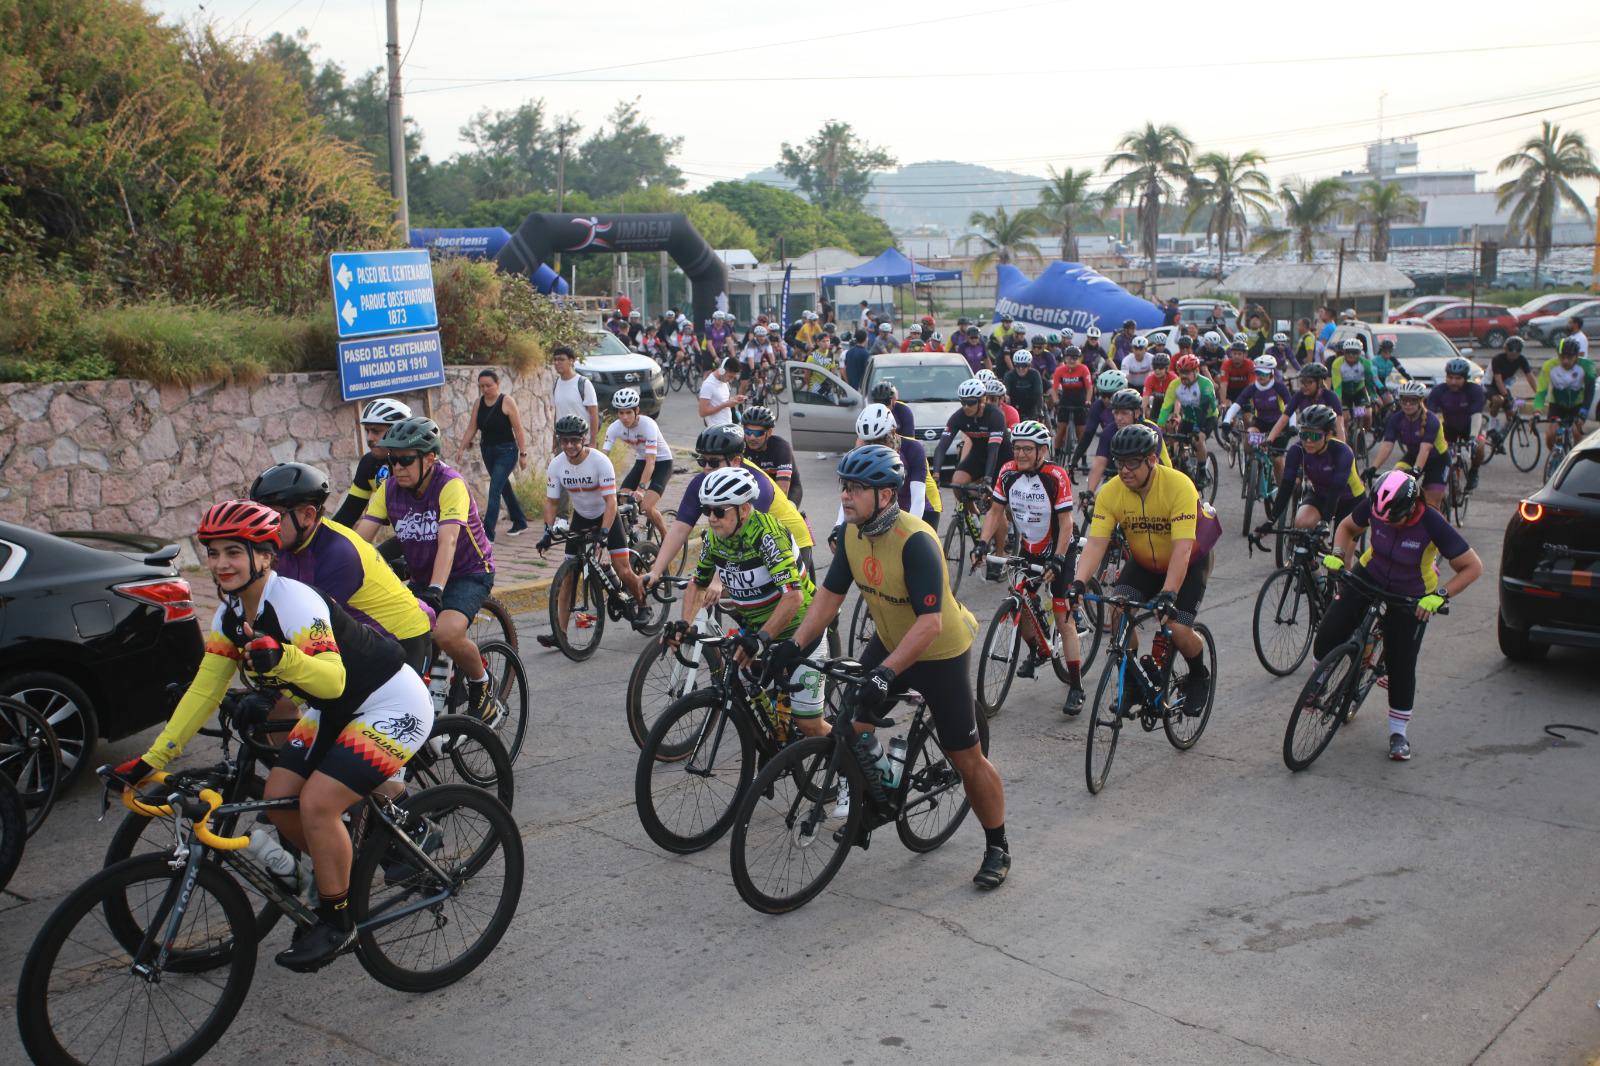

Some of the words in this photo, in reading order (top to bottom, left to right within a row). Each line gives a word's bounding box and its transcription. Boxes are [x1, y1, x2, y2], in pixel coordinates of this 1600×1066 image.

[616, 220, 672, 239] IMDEM
[357, 266, 379, 284] PASEO
[378, 266, 391, 284] DEL
[392, 263, 430, 283] CENTENARIO
[360, 292, 387, 311] PARQUE
[387, 288, 433, 308] OBSERVATORIO
[388, 309, 407, 325] 1873
[344, 348, 371, 363] PASEO
[373, 345, 388, 359] DEL
[390, 340, 437, 357] CENTENARIO
[360, 361, 396, 377] INICIADO
[397, 359, 409, 371] EN
[409, 356, 428, 370] 1910
[361, 730, 407, 761] CULIACÁN
